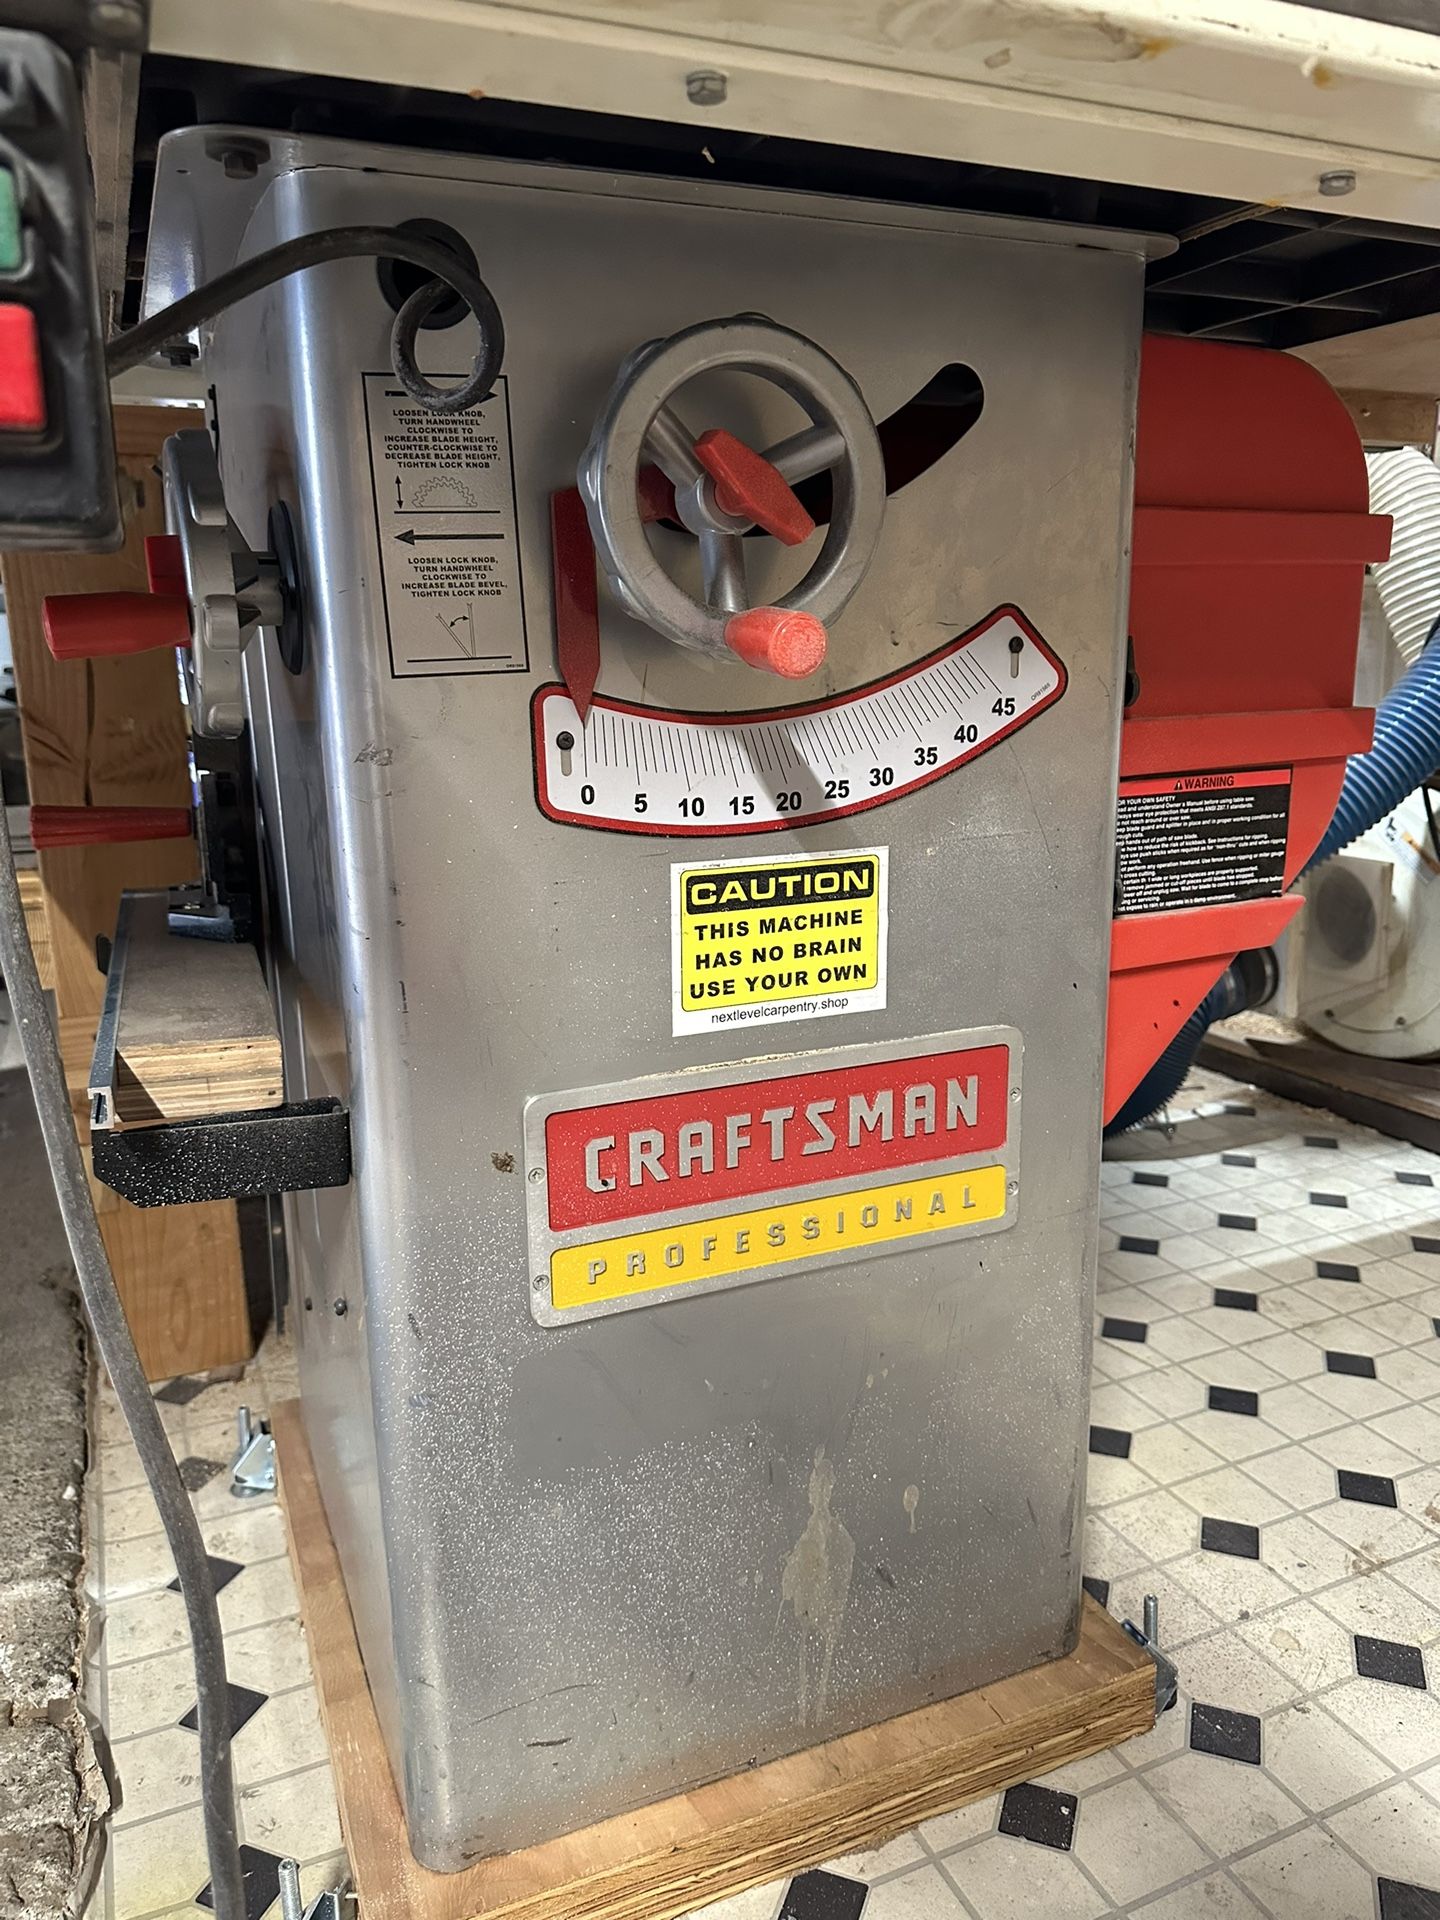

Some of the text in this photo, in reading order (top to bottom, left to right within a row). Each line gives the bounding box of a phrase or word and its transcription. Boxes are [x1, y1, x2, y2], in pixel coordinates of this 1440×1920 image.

[393, 409, 429, 417] LOOSEN
[458, 410, 486, 418] KNOB,
[426, 418, 480, 426] HANDWHEEL
[384, 435, 429, 443] INCREASE
[463, 436, 499, 444] HEIGHT,
[387, 444, 498, 452] COUNTER-CLOCKWISE TO
[385, 452, 432, 460] DECREASE
[465, 453, 500, 461] HEIGHT,
[397, 461, 490, 469] TIGHTEN LOCK KNOB
[471, 556, 498, 564] KNOB,
[401, 582, 445, 590] INCREASE
[411, 590, 450, 598] TIGHTEN
[580, 697, 1016, 818] 0 5 10 15 20 25 30 35 40 45
[1184, 775, 1235, 790] WARNING
[1156, 795, 1175, 803] SAFETY
[690, 868, 869, 907] CAUTION
[695, 909, 863, 941] THIS MACHINE
[696, 936, 862, 970] HAS NO BRAIN
[690, 963, 867, 1000] USE YOUR OWN
[711, 996, 849, 1024] nextlevelcarpentry.shop
[583, 1074, 979, 1194] CRAFTSMAN
[587, 1185, 977, 1285] PROFESSIONAL
